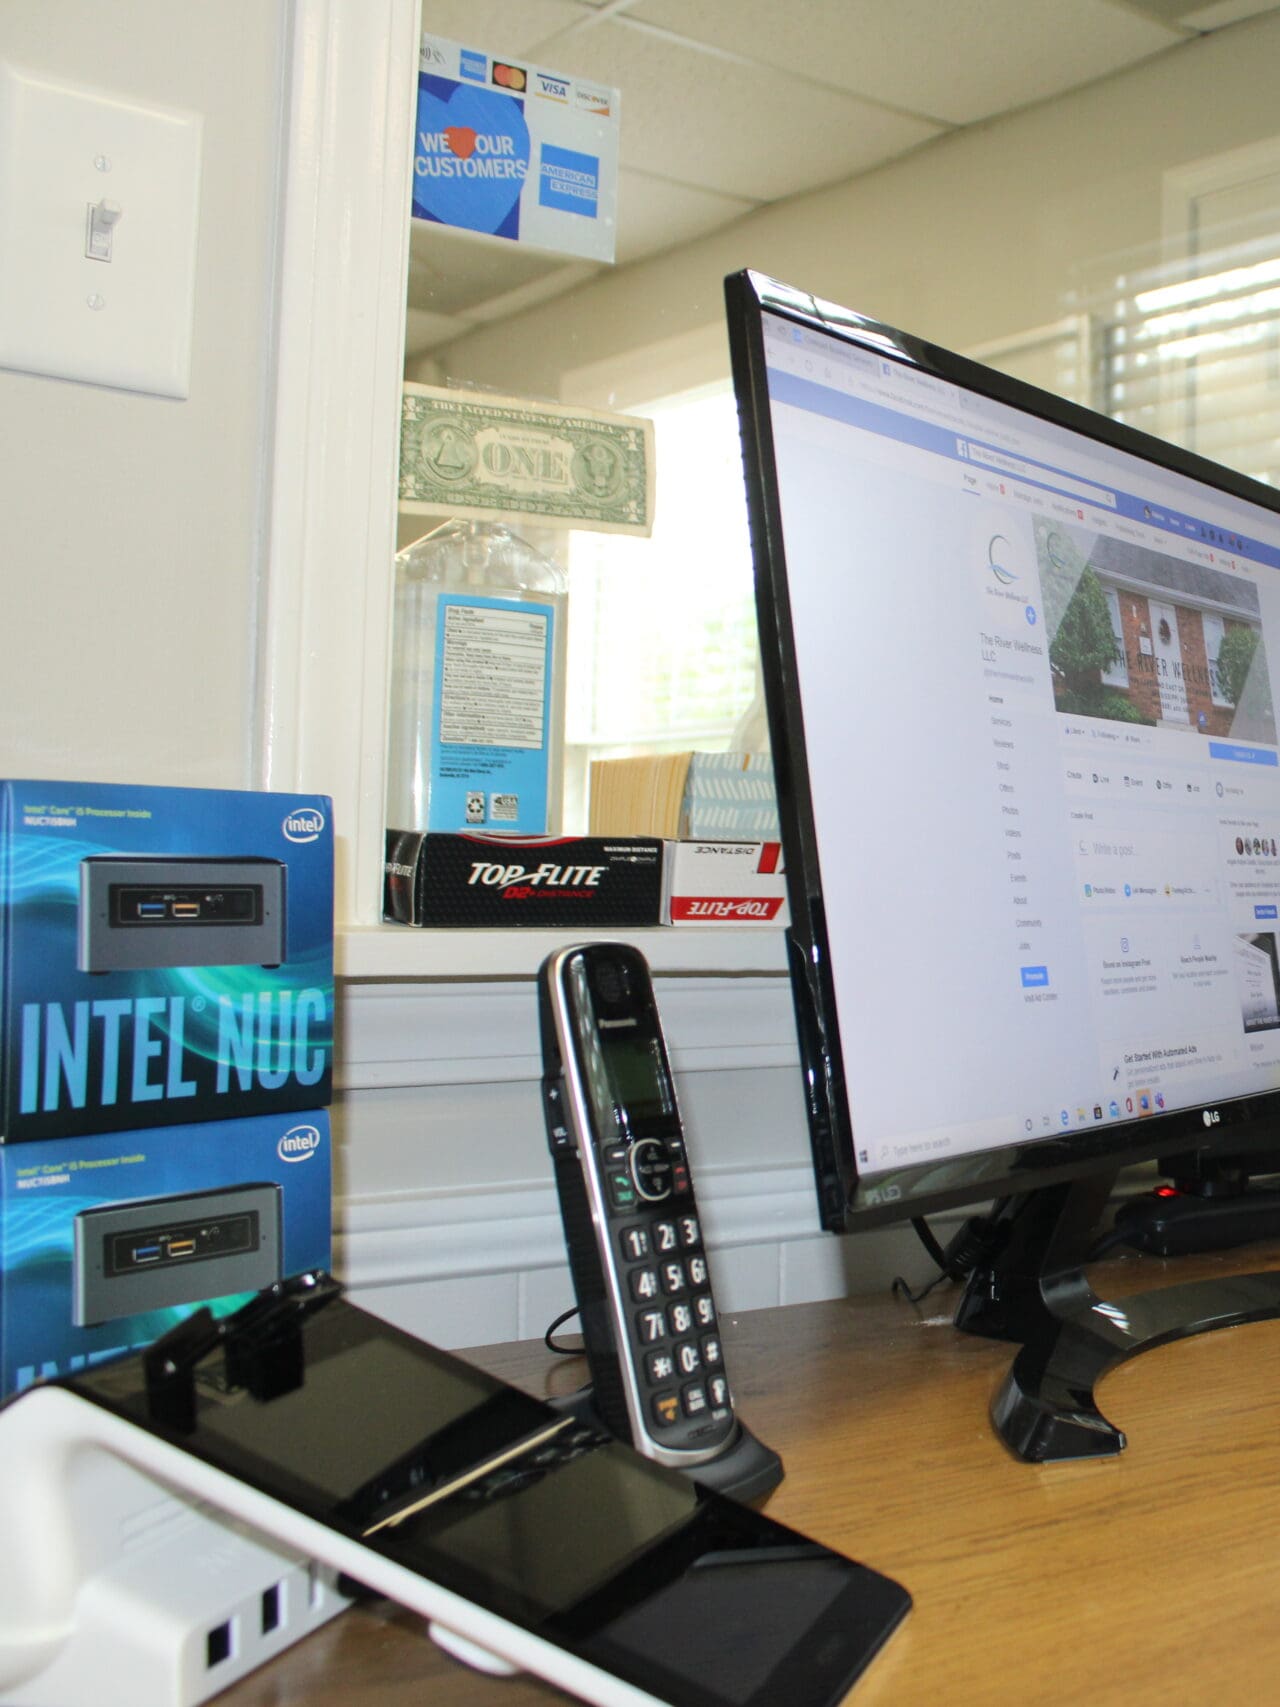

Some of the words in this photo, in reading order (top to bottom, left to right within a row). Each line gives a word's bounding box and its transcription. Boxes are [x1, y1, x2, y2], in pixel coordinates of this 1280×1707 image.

[541, 81, 567, 97] VISA
[420, 132, 449, 153] WE
[475, 135, 515, 155] OUR
[414, 157, 528, 180] CUSTOMERS
[541, 163, 595, 186] AMERICAN
[551, 181, 599, 199] EXPRESS
[562, 418, 615, 435] AMERICA
[482, 442, 569, 485] ONE
[980, 632, 994, 647] The
[994, 635, 1012, 650] River
[1013, 639, 1043, 656] Wellness
[1137, 651, 1169, 678] RIVER
[287, 813, 321, 833] intel
[694, 845, 756, 855] DISTANCE
[537, 889, 596, 899] DISTANCE
[215, 987, 327, 1095] NUC
[1124, 1054, 1133, 1064] Get
[1134, 1052, 1151, 1062] Started
[1152, 1050, 1162, 1059] With
[1163, 1046, 1188, 1057] Automated
[1210, 1110, 1221, 1124] LG
[282, 1134, 315, 1153] intel
